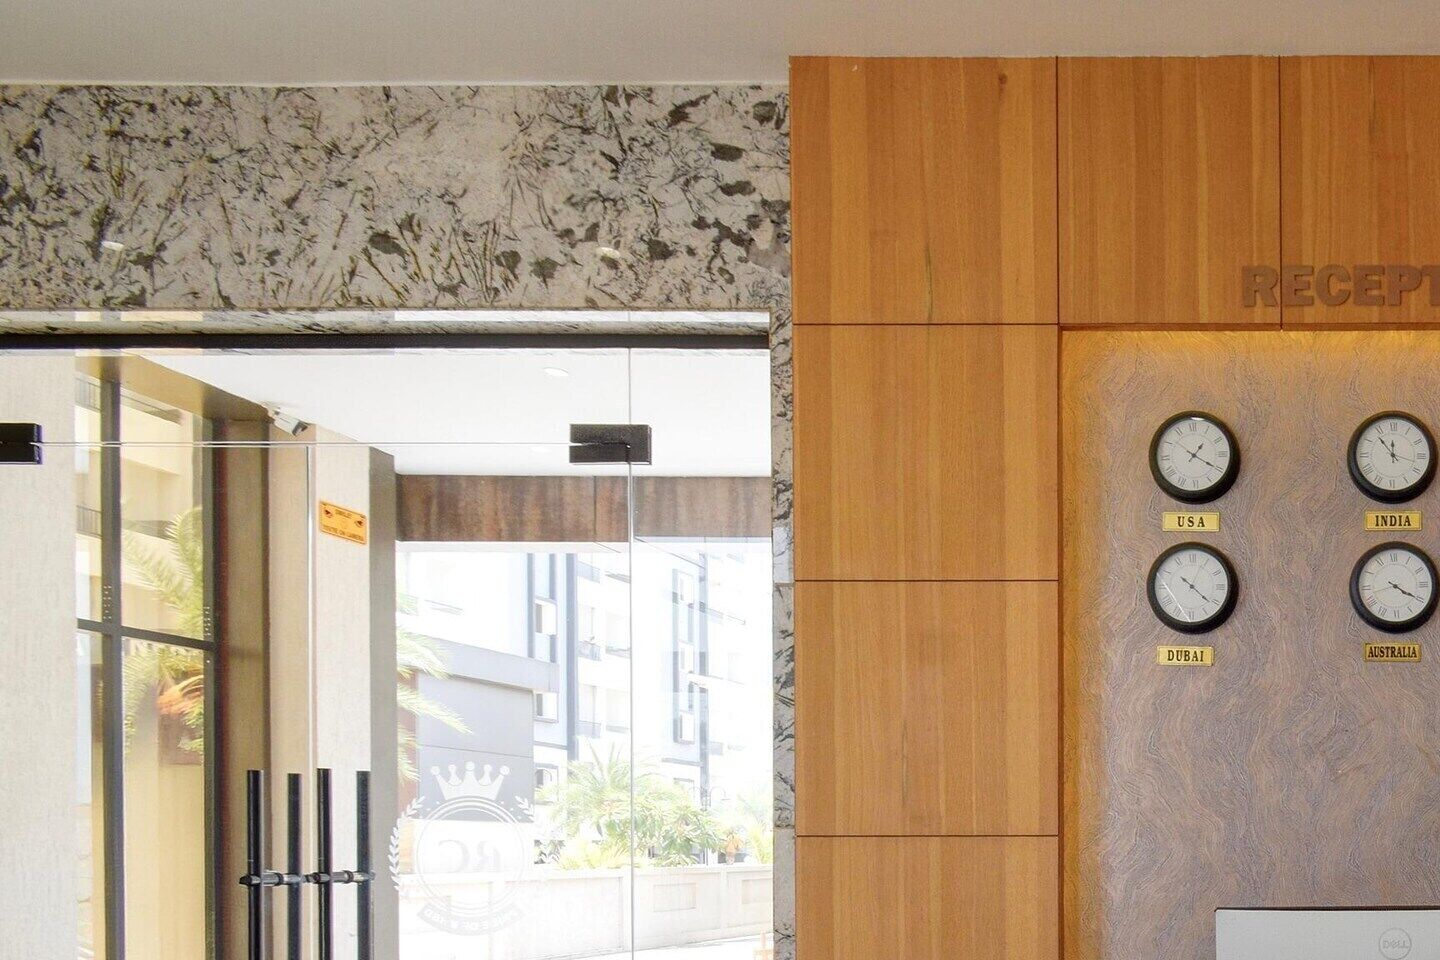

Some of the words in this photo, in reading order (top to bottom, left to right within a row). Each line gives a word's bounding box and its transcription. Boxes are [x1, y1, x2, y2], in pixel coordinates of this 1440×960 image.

[1177, 516, 1206, 527] USA
[1375, 515, 1412, 527] INDIA
[1167, 650, 1204, 662] DUBAI
[1367, 646, 1417, 658] AUSTRALIA
